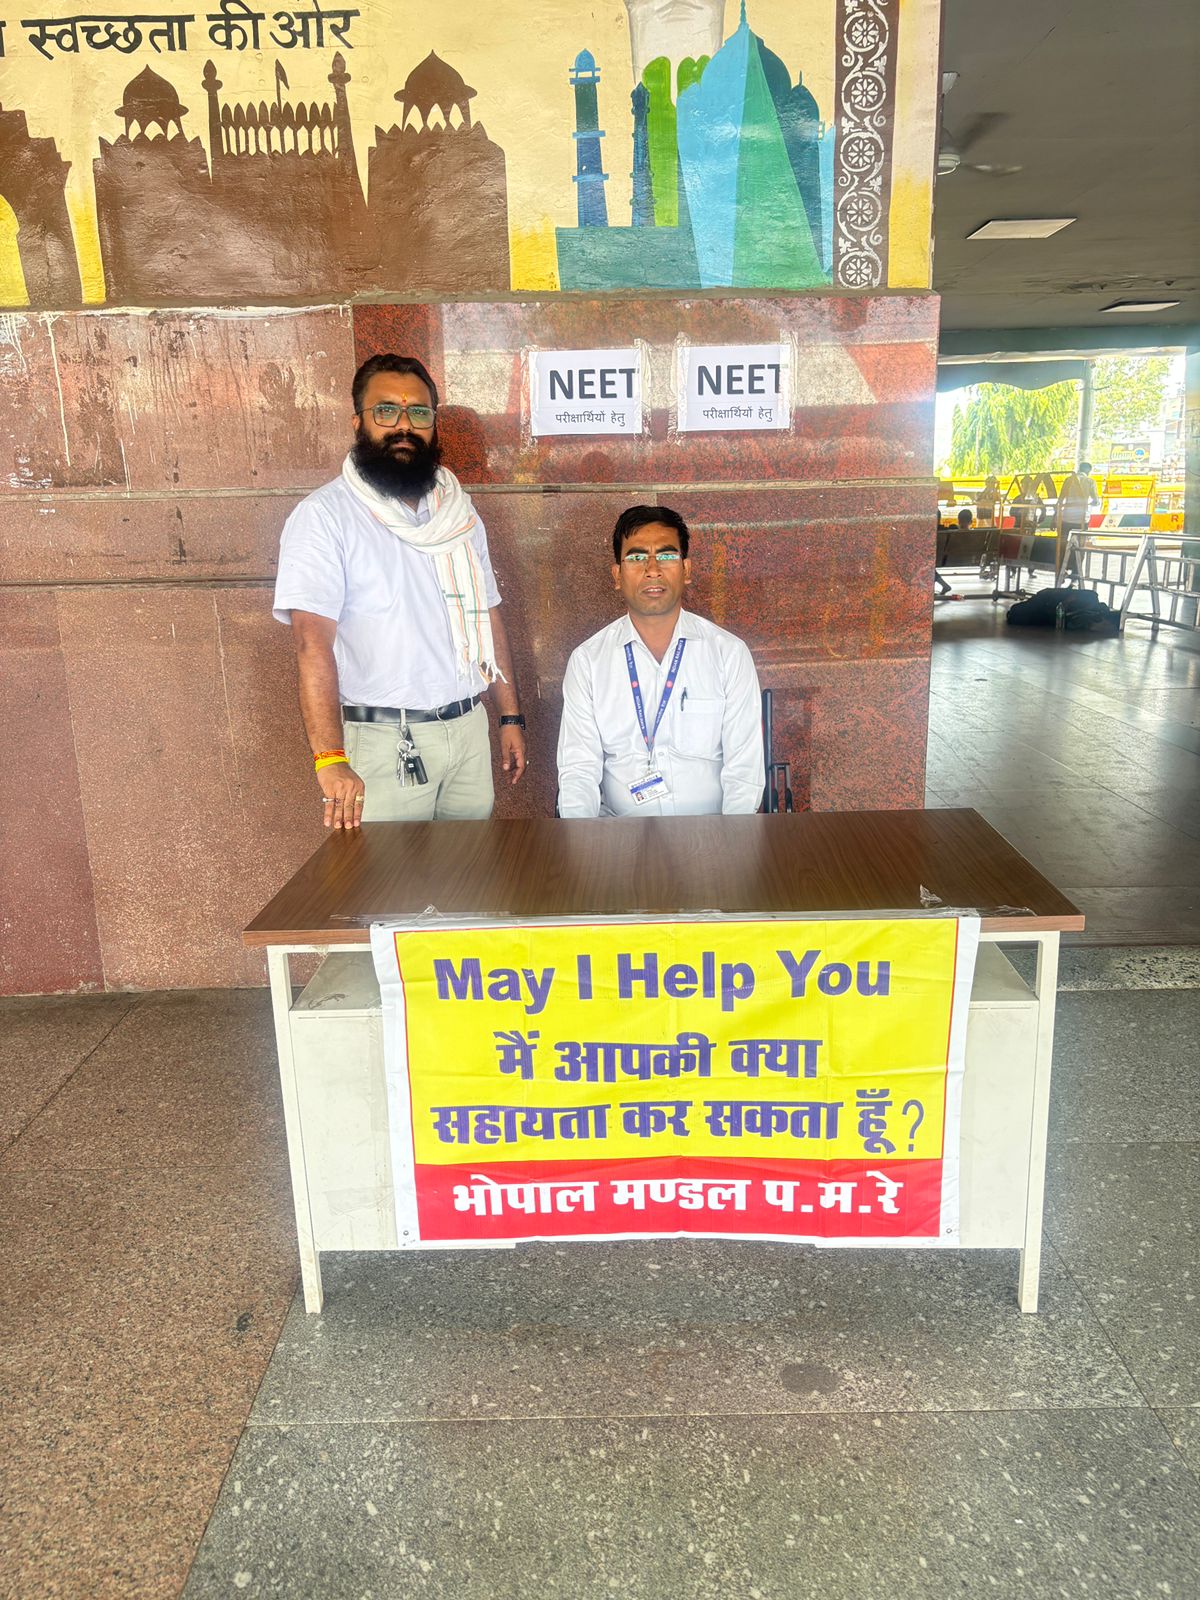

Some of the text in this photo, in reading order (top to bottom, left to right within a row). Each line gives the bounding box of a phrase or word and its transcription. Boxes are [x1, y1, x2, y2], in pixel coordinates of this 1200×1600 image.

[20, 14, 195, 60] स्वच्छता
[206, 0, 265, 50] की
[269, 0, 360, 49] ओर
[550, 368, 639, 400] NEET
[697, 363, 788, 396] NEET
[555, 410, 626, 427] परीक्षार्थियों हेतु
[702, 405, 773, 423] परीक्षार्थियों हेतु
[433, 950, 891, 1015] May I Help You
[493, 1030, 823, 1083] मैं आपकी क्या
[430, 1104, 611, 1145] सहायता
[620, 1100, 693, 1138] कर
[704, 1100, 844, 1140] सकता
[452, 1173, 599, 1216] भोपाल
[610, 1177, 752, 1211] मण्डल
